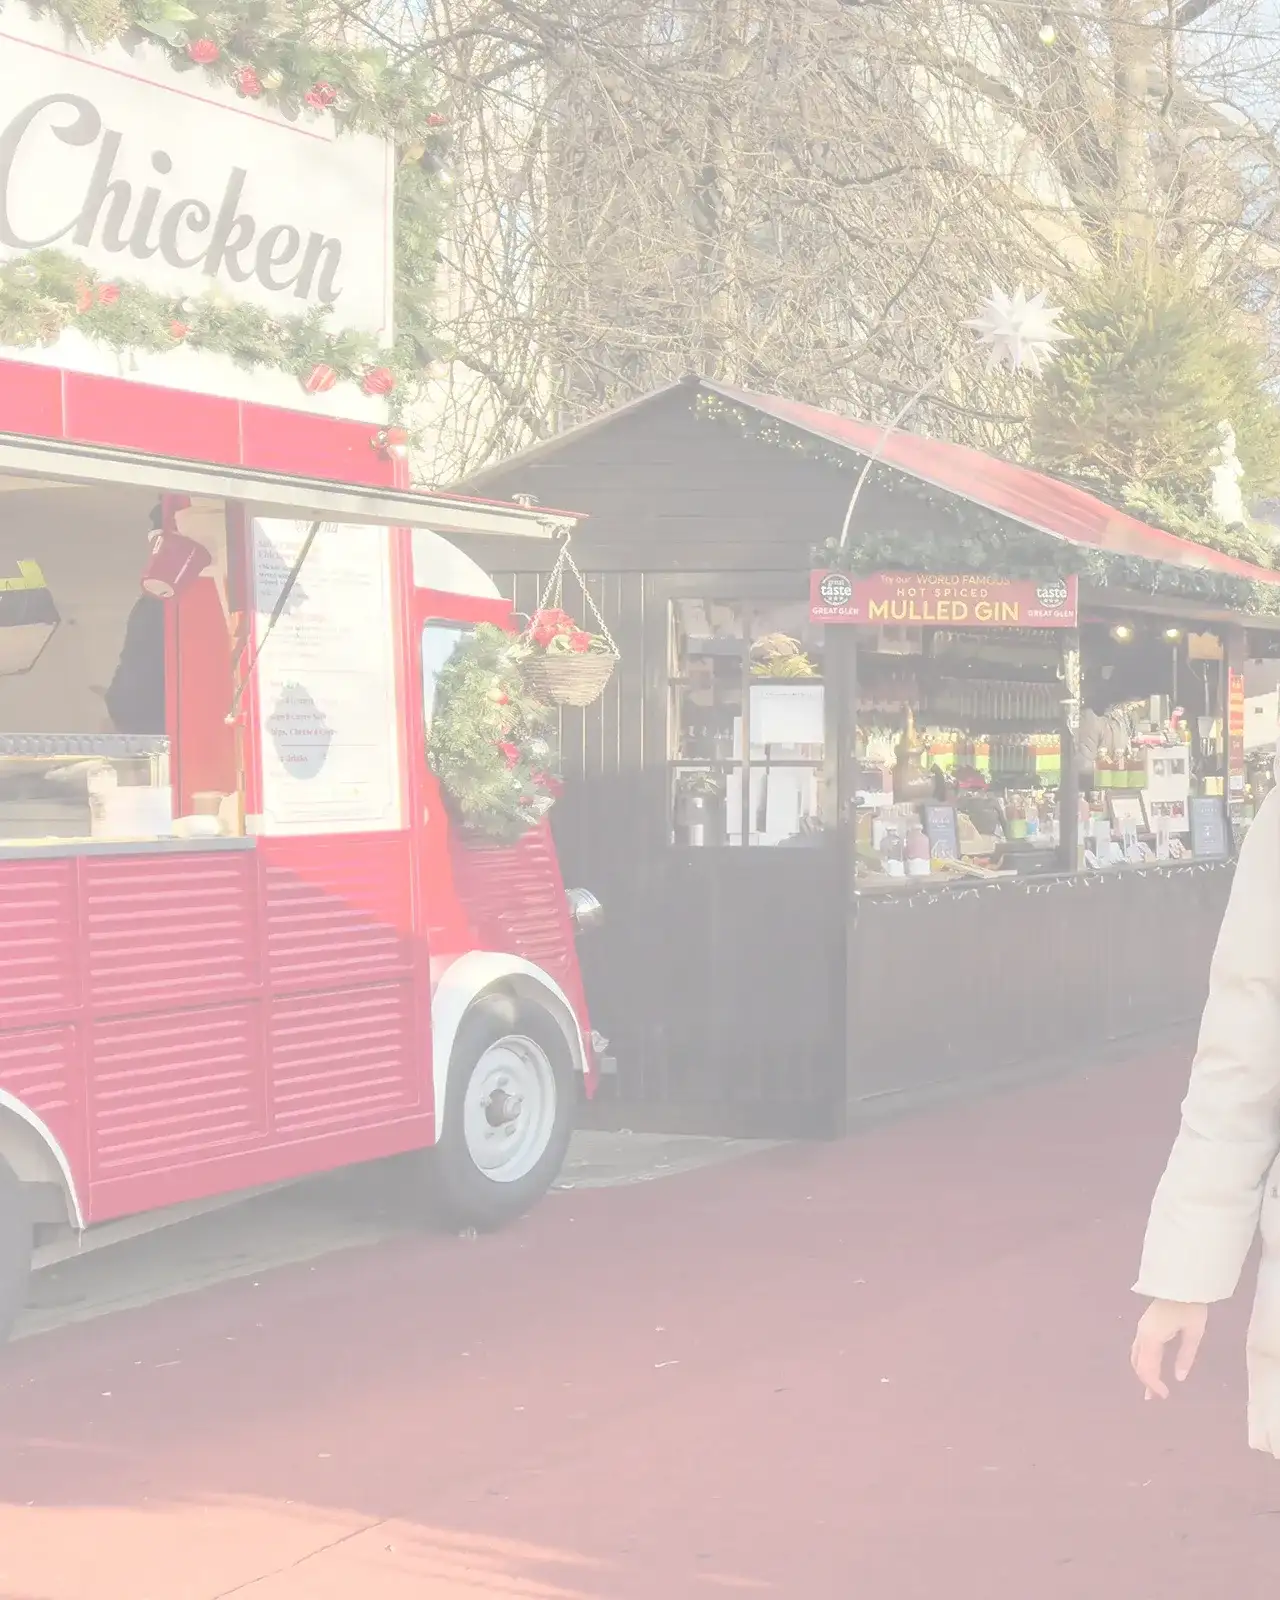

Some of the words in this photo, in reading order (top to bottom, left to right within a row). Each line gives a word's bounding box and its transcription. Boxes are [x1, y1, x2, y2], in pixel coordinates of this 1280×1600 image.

[0, 92, 343, 302] Chicken
[880, 574, 895, 585] Try
[896, 576, 912, 584] our
[916, 574, 959, 585] WORLD
[962, 575, 1011, 586] FAMOUS
[821, 586, 852, 596] taste
[896, 588, 926, 597] HOT
[934, 588, 989, 598] SPICED
[1036, 588, 1067, 598] taste
[812, 606, 838, 615] GREAT
[839, 606, 859, 615] GLEN
[868, 599, 968, 621] MULLED
[975, 601, 1019, 622] GIN
[1027, 609, 1052, 618] GREAT
[1053, 609, 1075, 618] GLEN
